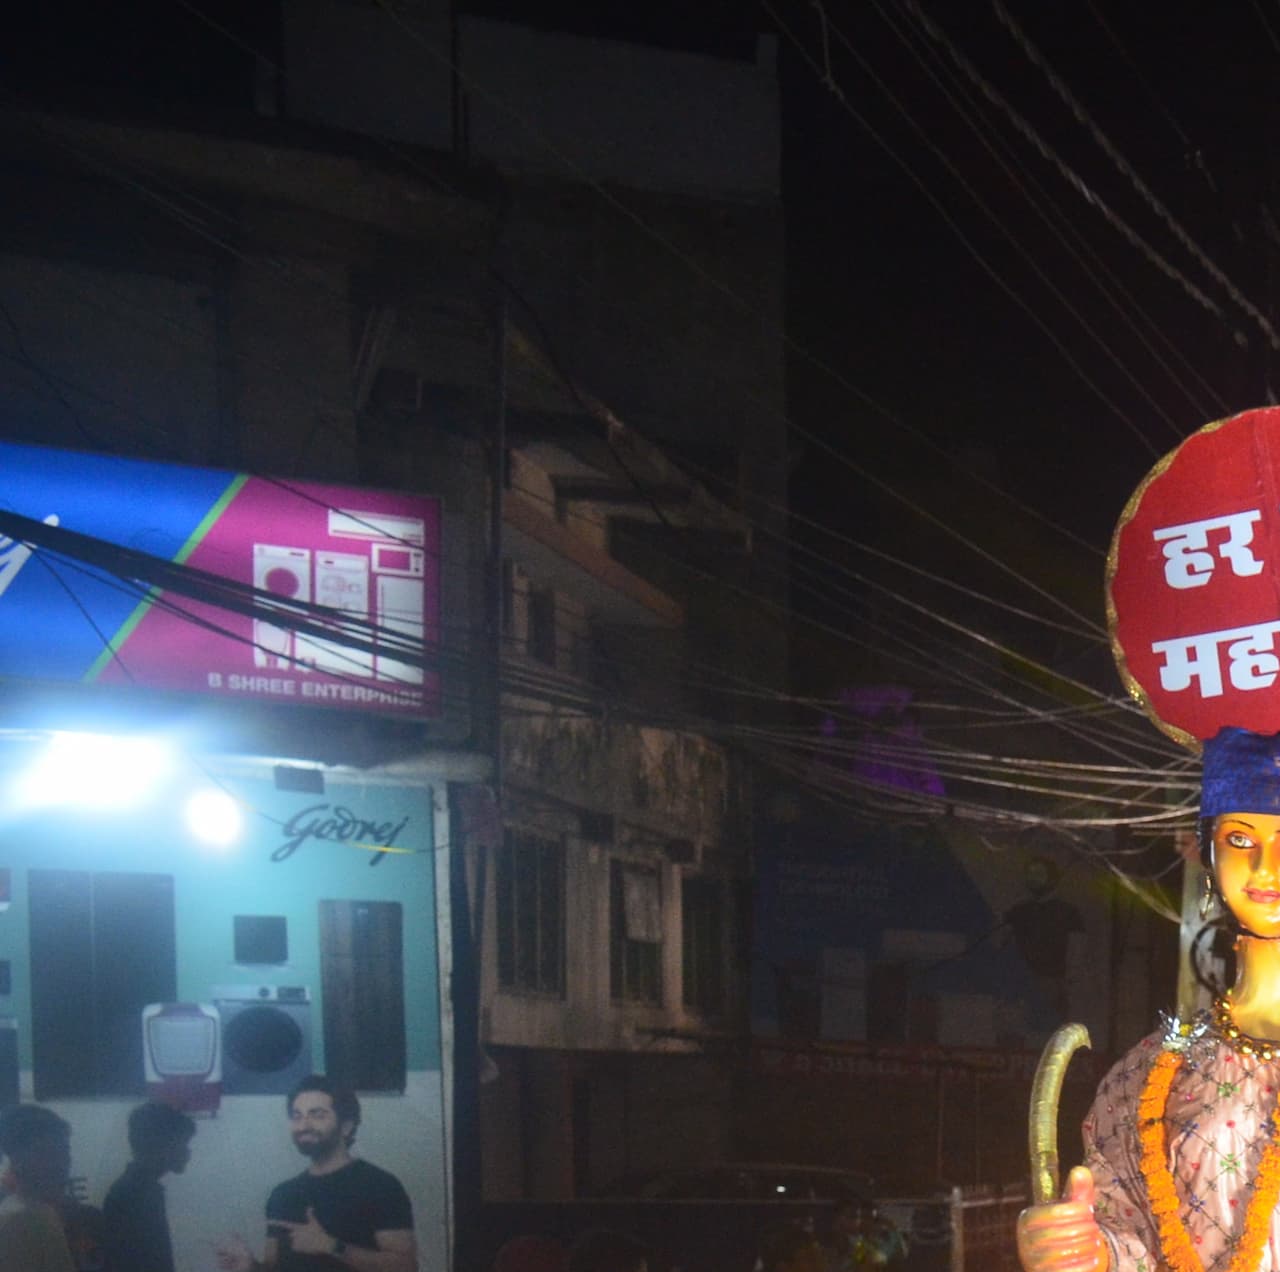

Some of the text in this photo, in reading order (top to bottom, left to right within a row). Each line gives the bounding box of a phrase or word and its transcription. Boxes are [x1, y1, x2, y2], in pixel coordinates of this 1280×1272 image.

[1153, 509, 1264, 589] हर
[208, 672, 221, 688] B
[228, 674, 296, 696] SHREE
[270, 803, 410, 867] Godrej
